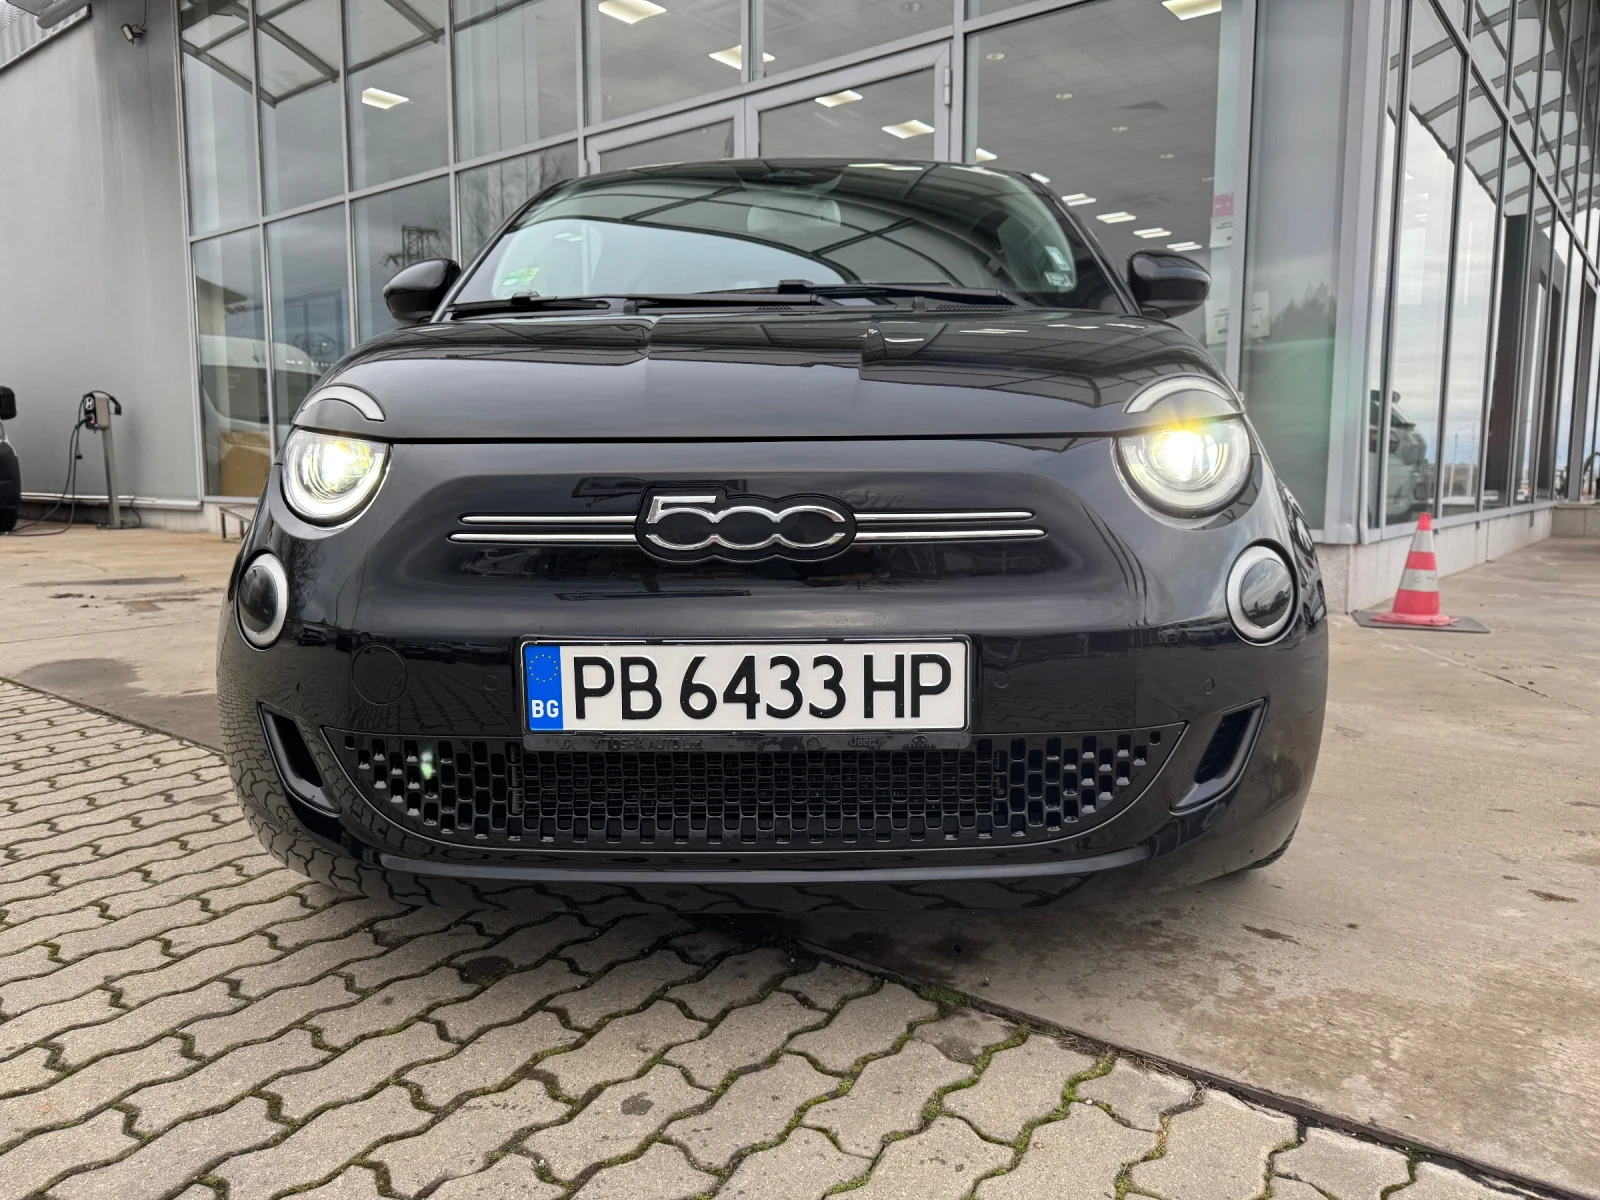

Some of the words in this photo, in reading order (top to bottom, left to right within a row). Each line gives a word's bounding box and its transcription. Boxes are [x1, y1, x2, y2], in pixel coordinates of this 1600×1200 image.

[646, 496, 846, 551] 500
[573, 655, 662, 720] PB
[679, 654, 847, 720] 6433
[863, 653, 952, 719] HP
[531, 699, 559, 718] BG
[591, 736, 646, 750] VITOSHA
[649, 736, 681, 750] AUTO
[848, 736, 877, 749] Jeep
